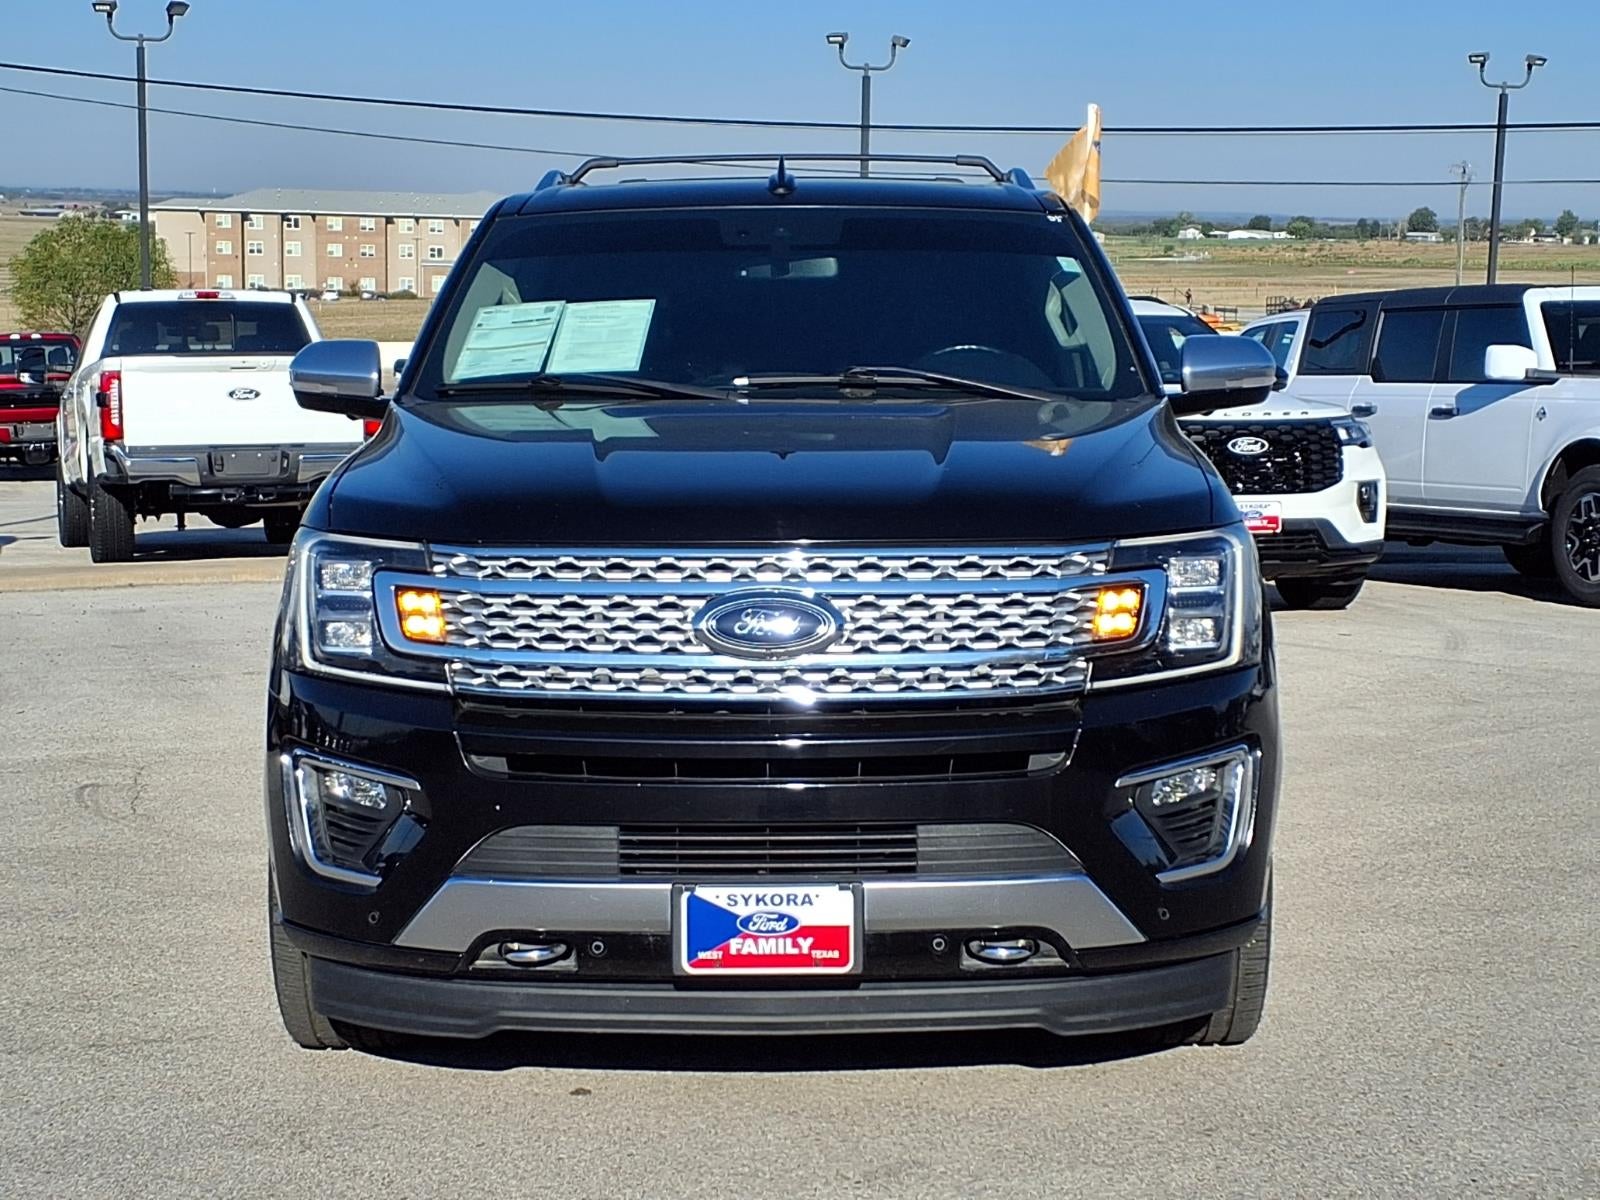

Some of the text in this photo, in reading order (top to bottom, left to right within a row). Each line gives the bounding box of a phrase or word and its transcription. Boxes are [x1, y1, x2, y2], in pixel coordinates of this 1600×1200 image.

[1235, 439, 1262, 451] Ford
[1244, 519, 1268, 527] AMILY
[726, 893, 814, 907] SYKORA
[748, 912, 788, 932] Ford
[729, 937, 814, 955] FAMILY
[697, 950, 839, 959] WEST TEXAS
